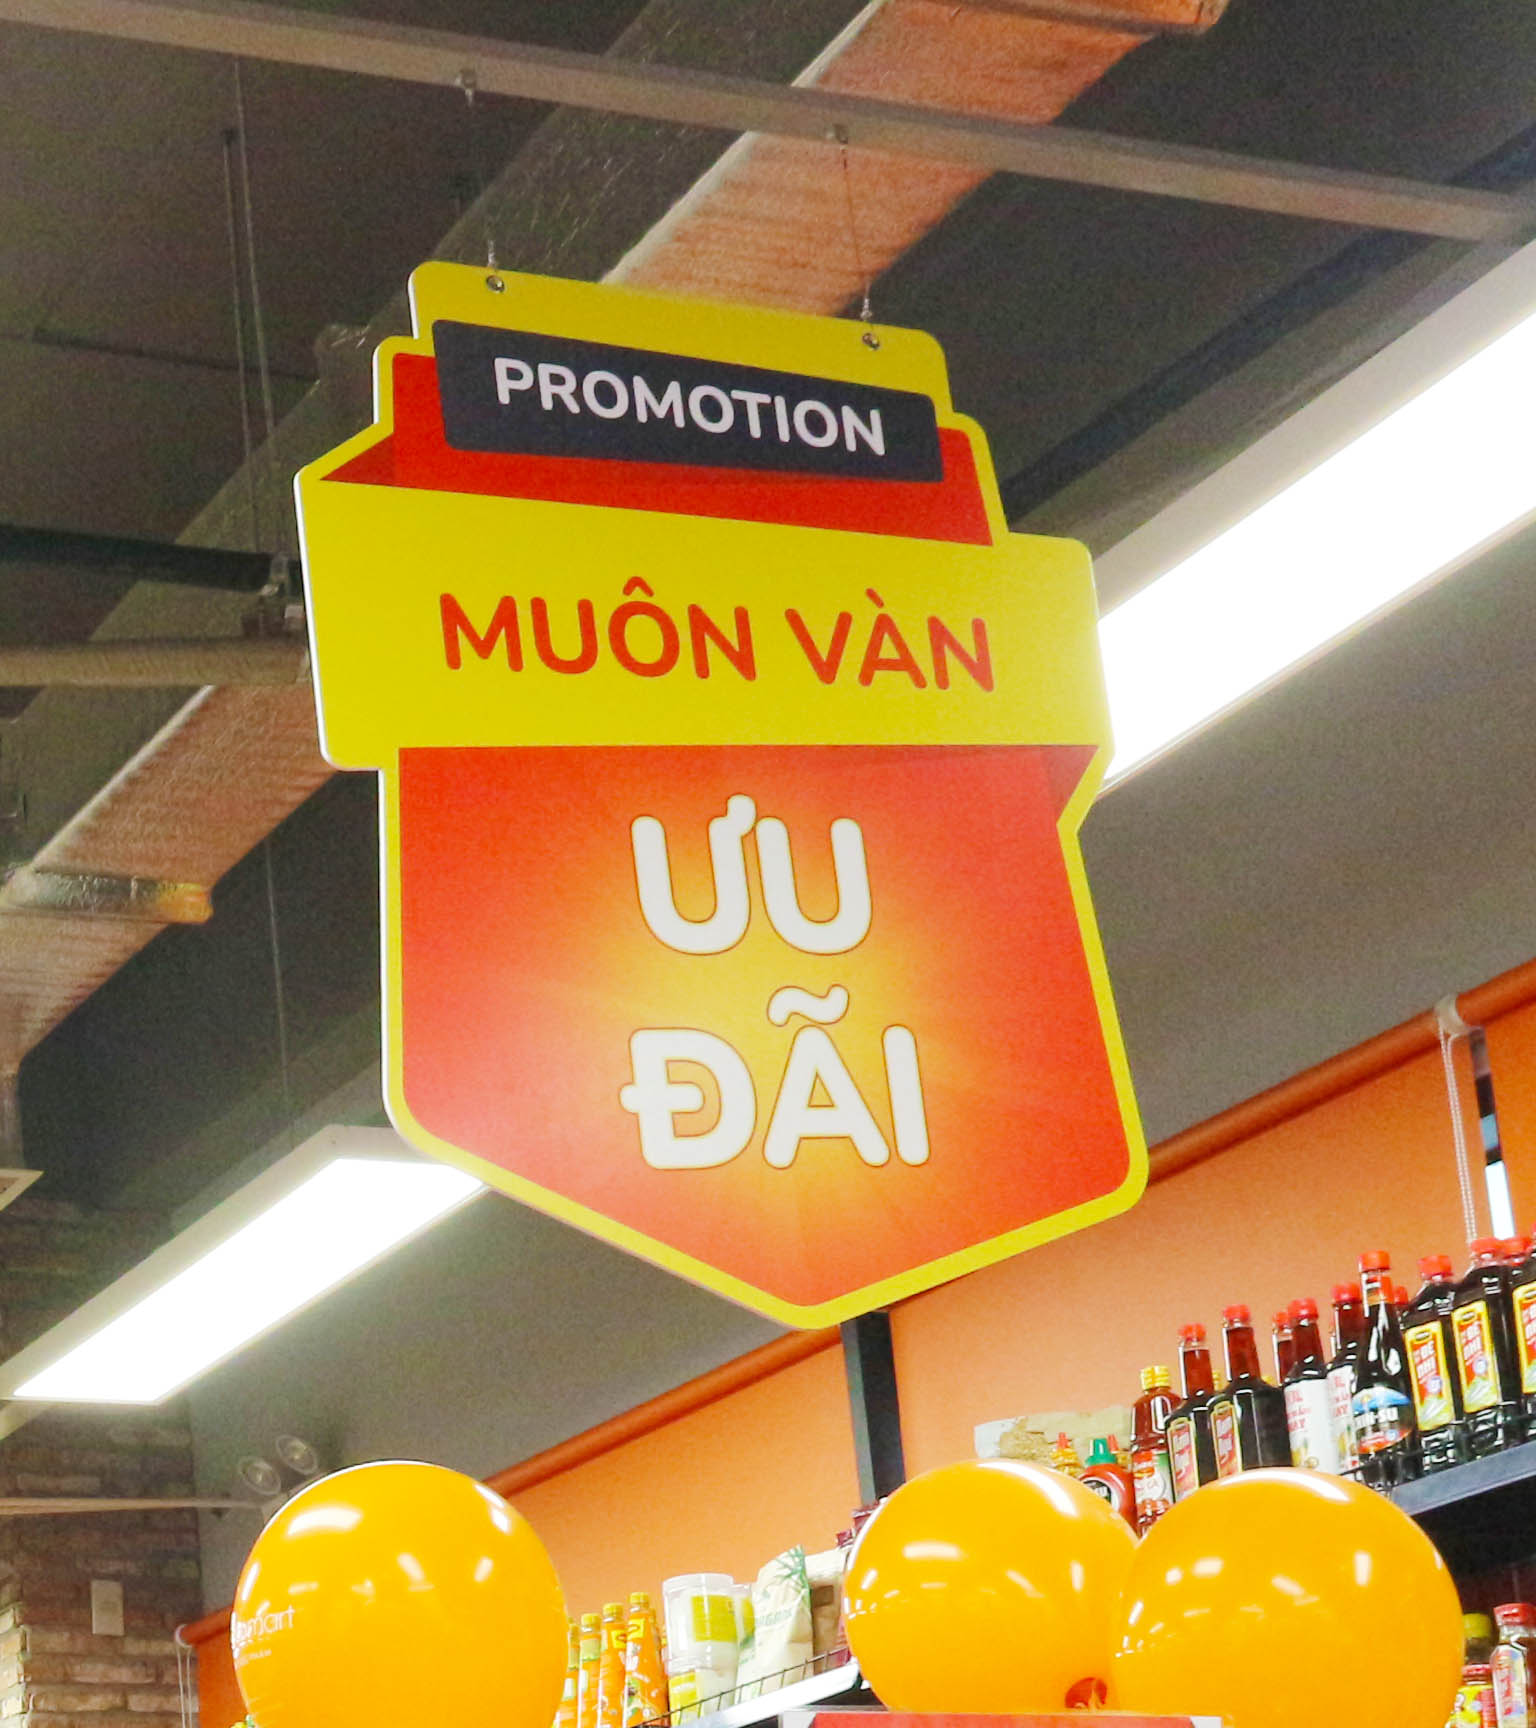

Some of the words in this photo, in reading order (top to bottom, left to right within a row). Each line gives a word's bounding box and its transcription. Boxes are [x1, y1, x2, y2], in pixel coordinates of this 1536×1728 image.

[494, 356, 887, 457] PROMOTION
[440, 576, 756, 682] MUÔN
[785, 588, 994, 693] VÀN
[630, 794, 872, 956] ƯU
[620, 984, 930, 1169] ĐÃI
